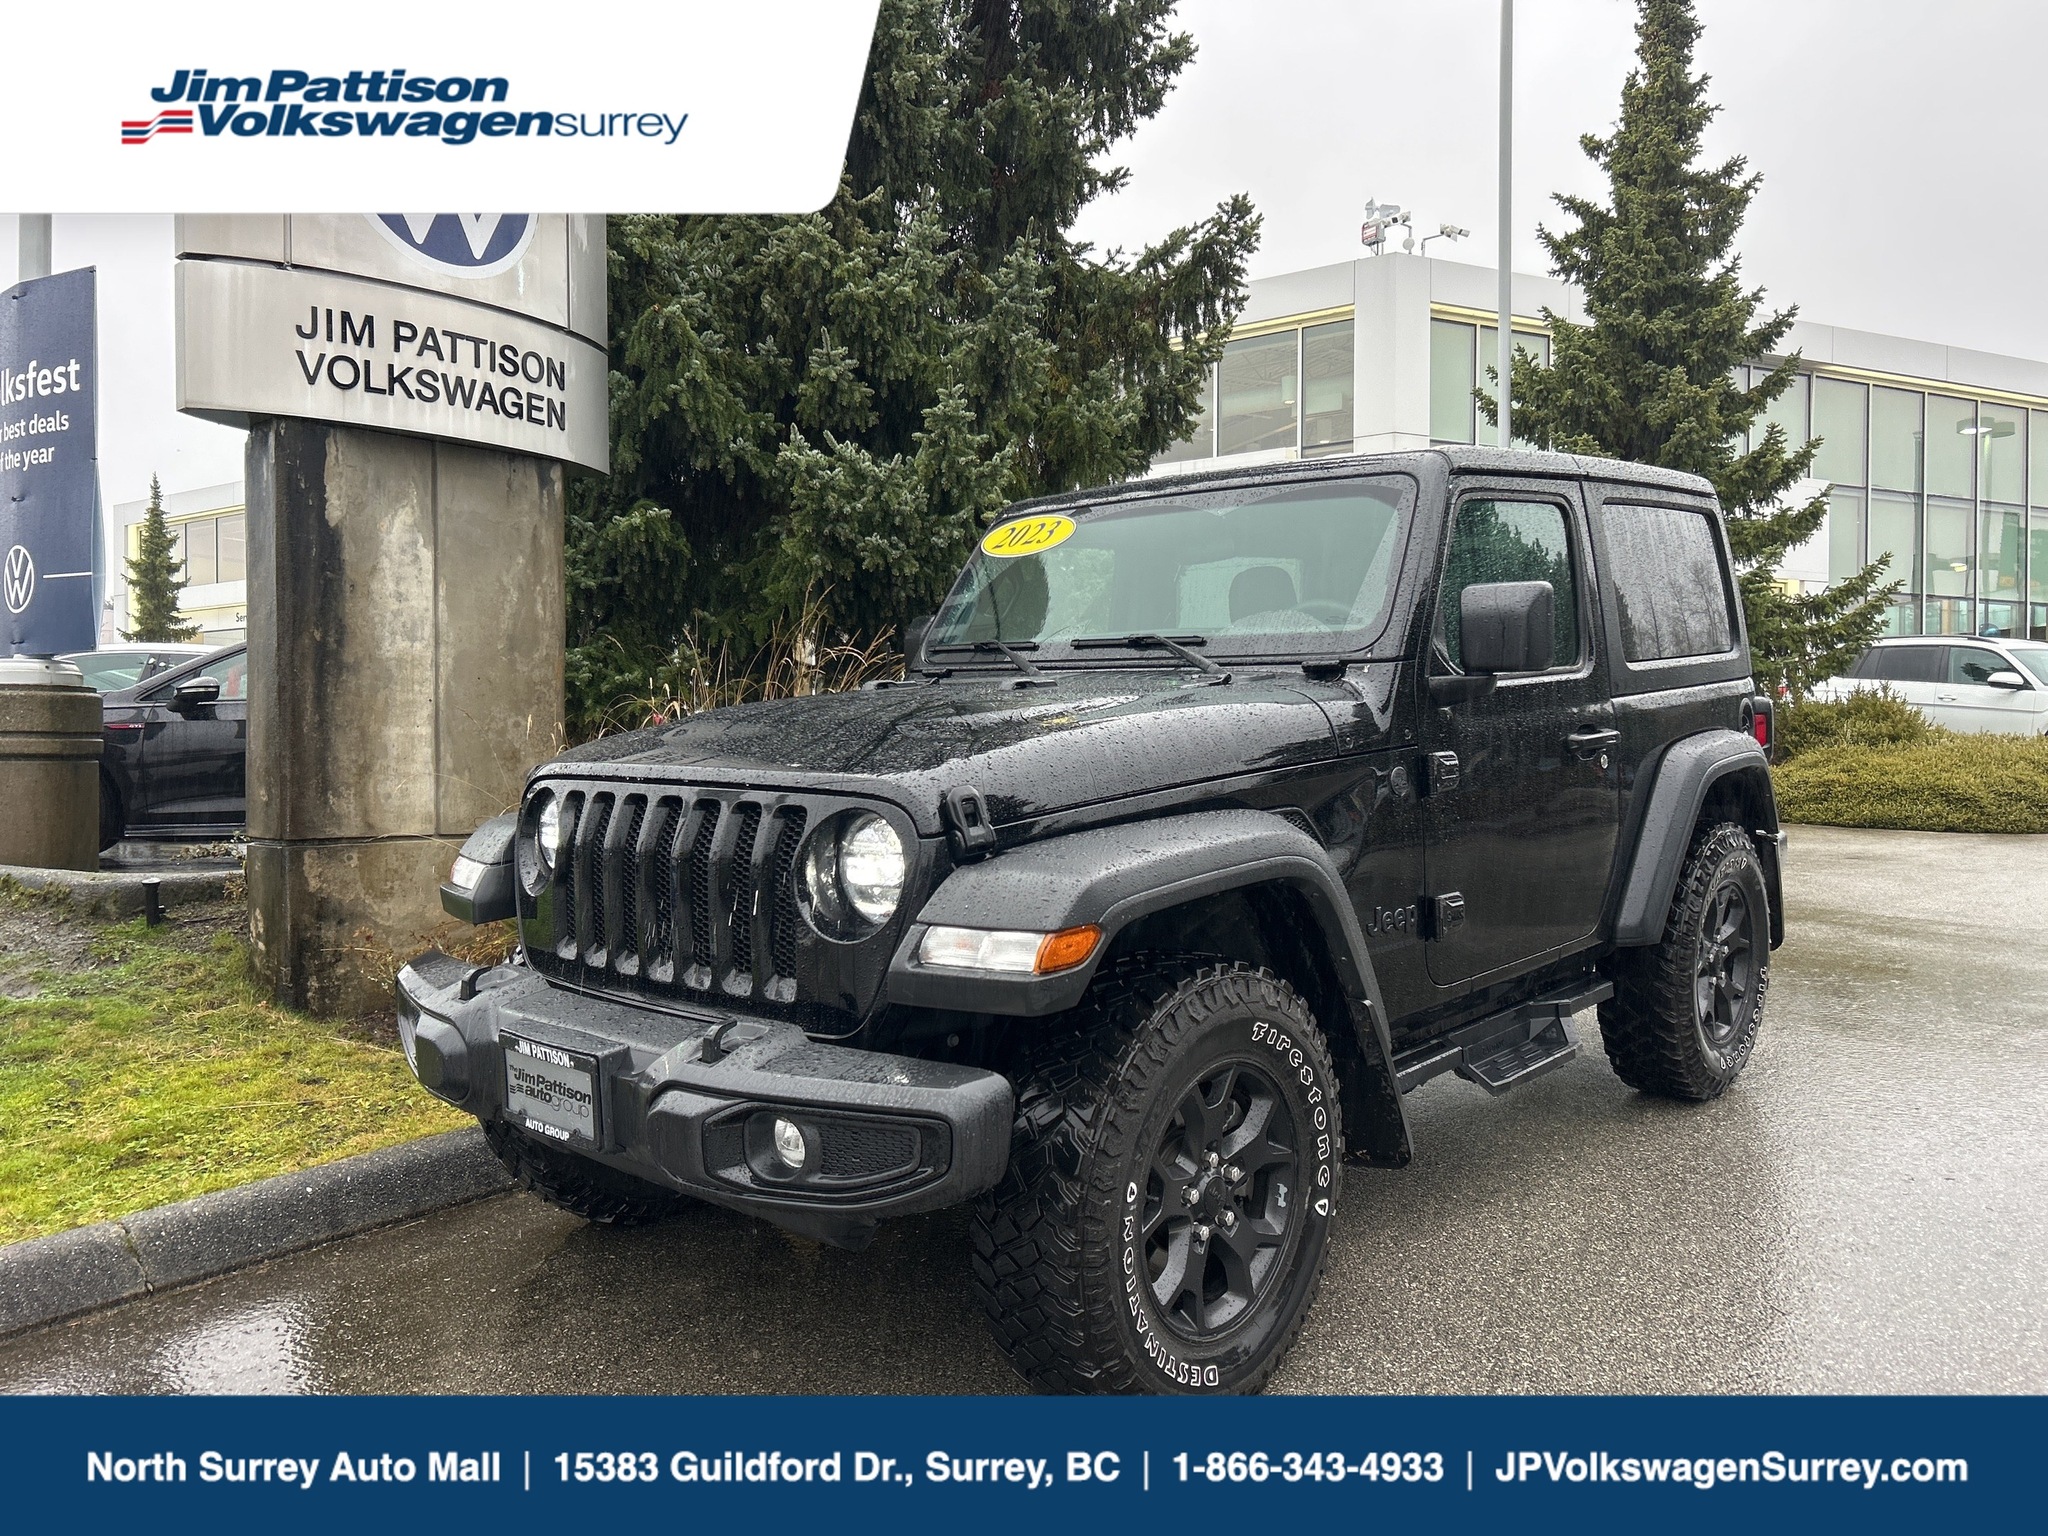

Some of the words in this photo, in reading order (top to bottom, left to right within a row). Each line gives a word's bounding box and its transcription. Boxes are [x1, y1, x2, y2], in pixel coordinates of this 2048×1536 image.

[295, 305, 375, 349] JIM
[393, 320, 566, 391] PATTISON
[295, 349, 566, 431] VOLKSWAGEN
[28, 410, 69, 435] deals
[5, 448, 20, 471] the
[22, 446, 55, 471] year
[991, 520, 1062, 550] 2023
[518, 1040, 531, 1057] JIM
[531, 1045, 570, 1068] PATTISON
[525, 1118, 544, 1133] AUTO
[544, 1124, 570, 1141] GROUP
